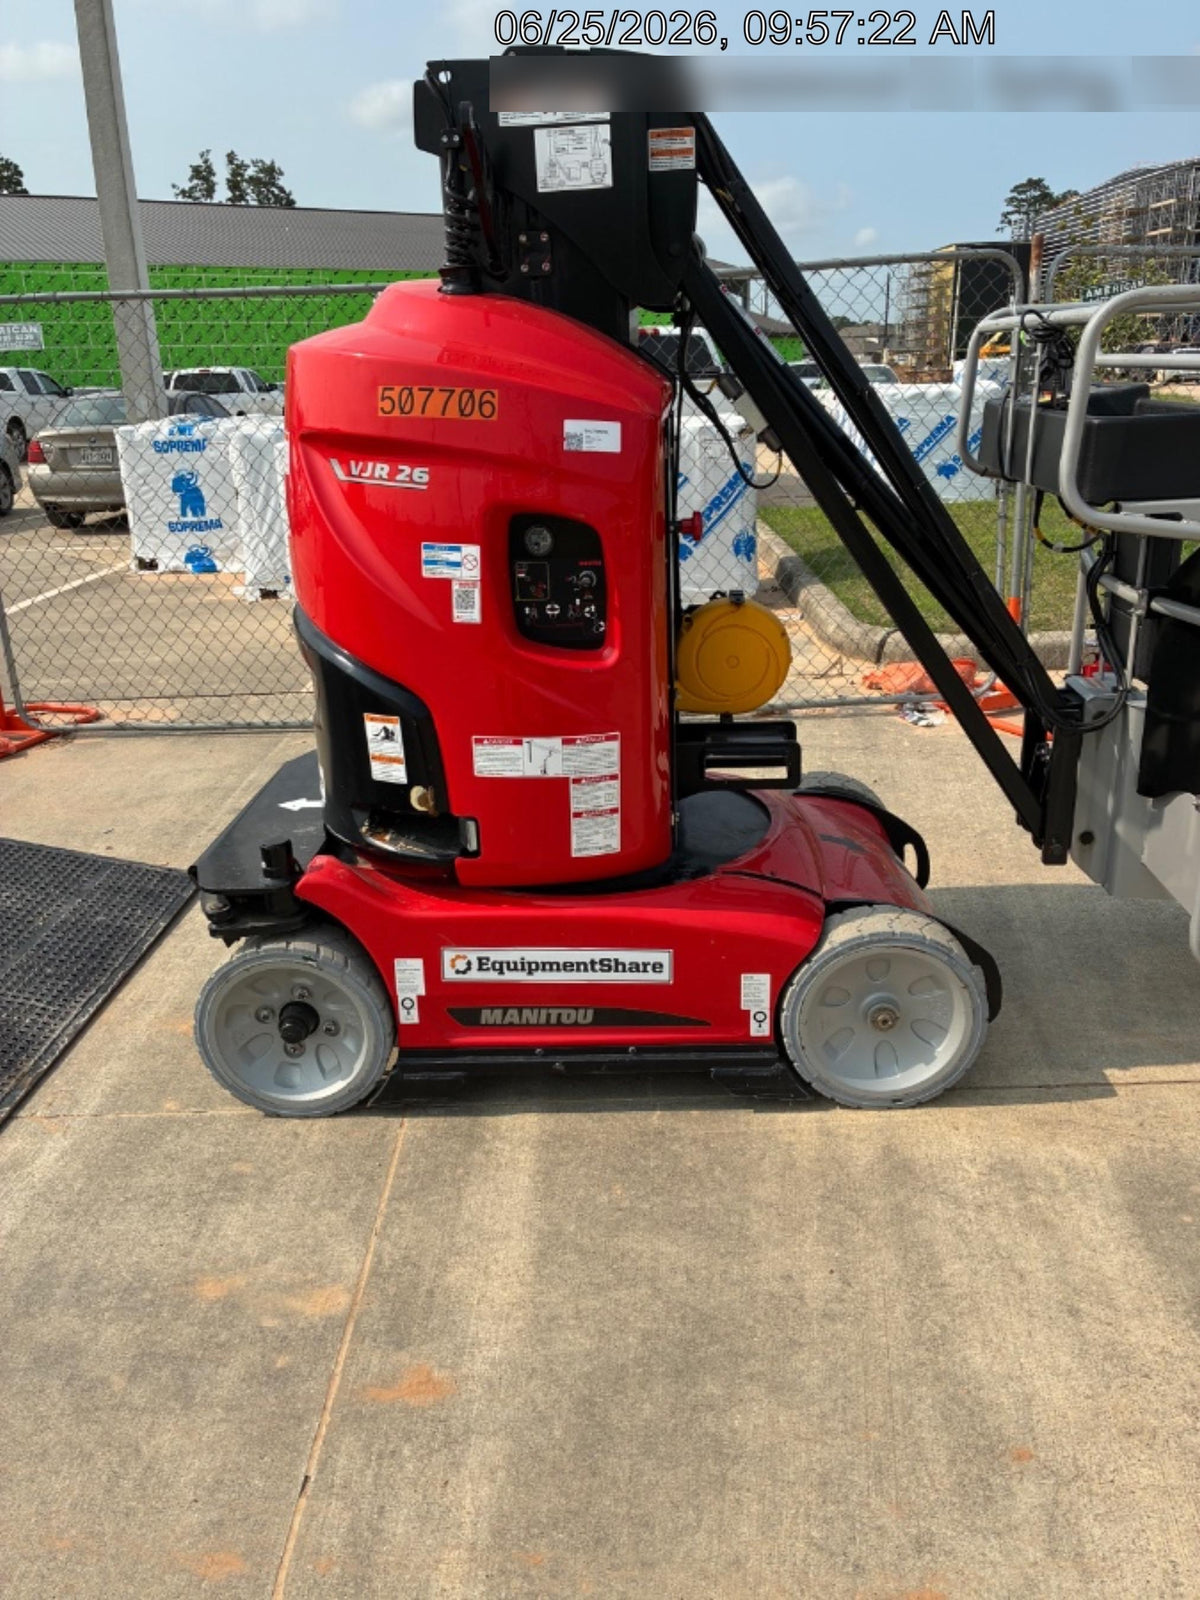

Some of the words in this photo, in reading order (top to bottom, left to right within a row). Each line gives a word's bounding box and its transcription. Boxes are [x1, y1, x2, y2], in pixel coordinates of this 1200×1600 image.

[380, 387, 497, 419] 507706
[350, 460, 390, 479] VJR
[395, 465, 430, 484] 26
[168, 519, 222, 532] SOPREMA
[476, 955, 664, 976] EquipmentShare
[480, 1008, 594, 1025] MANITOU
